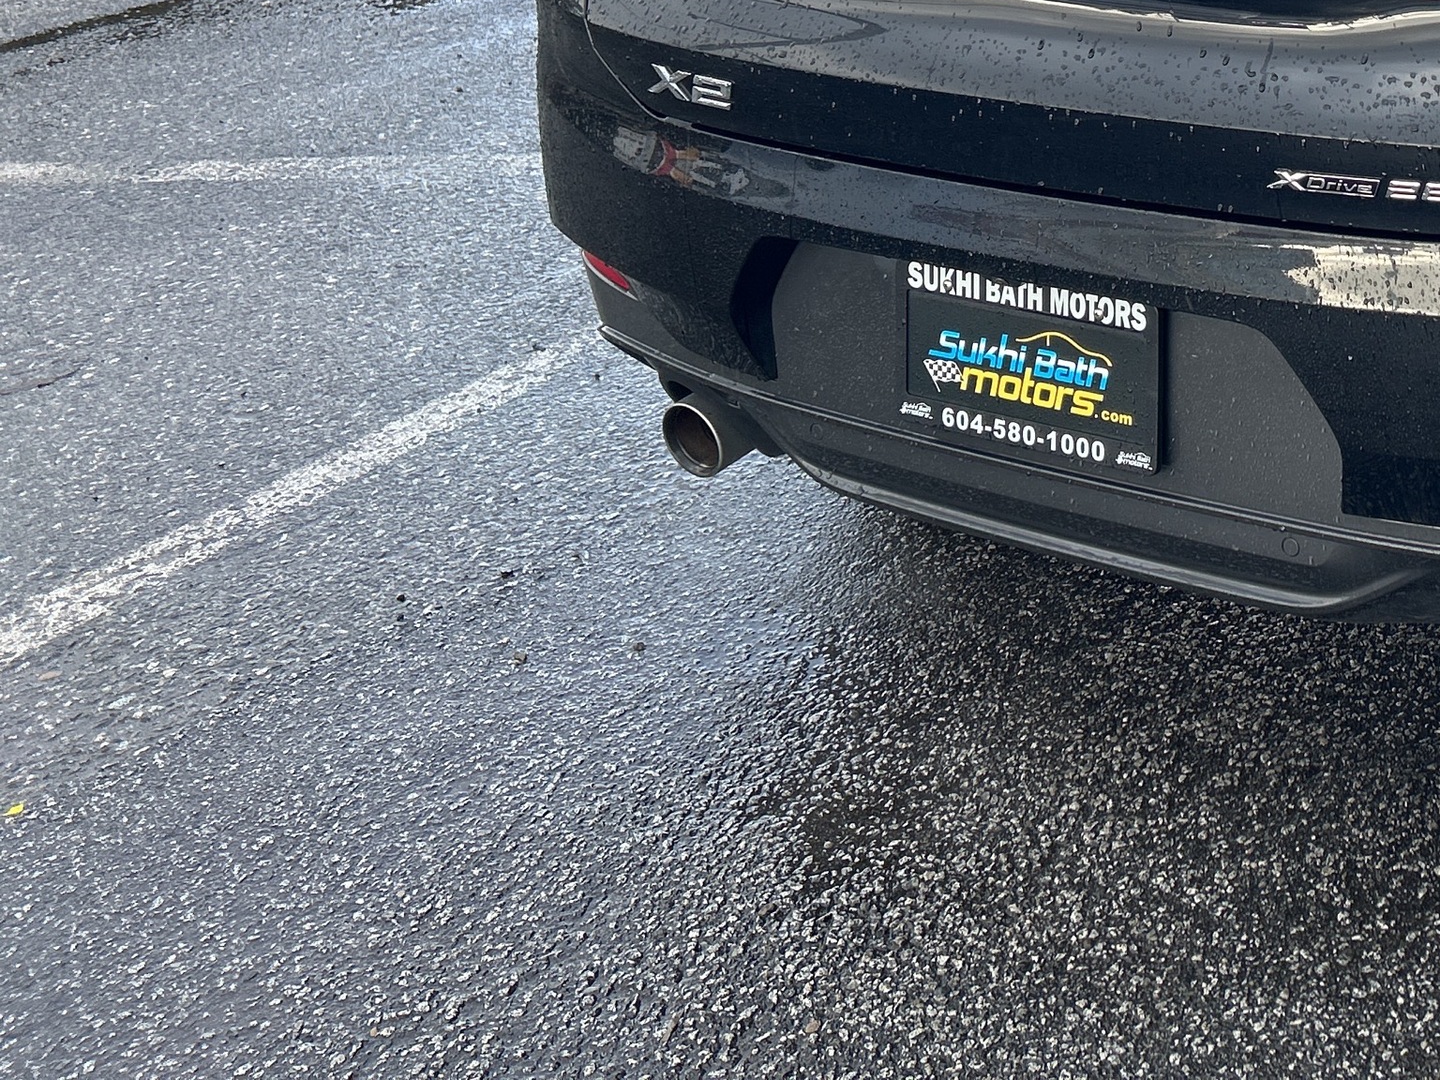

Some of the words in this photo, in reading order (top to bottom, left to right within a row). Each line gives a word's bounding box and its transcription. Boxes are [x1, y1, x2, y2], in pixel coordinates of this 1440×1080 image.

[647, 63, 733, 111] X2
[907, 261, 980, 300] SUKHI
[985, 278, 1043, 311] BATH
[1050, 287, 1147, 331] MOTORS
[928, 329, 1027, 373] Sukhi
[1033, 348, 1110, 390] Bath
[941, 407, 1105, 461] 604-580-1000
